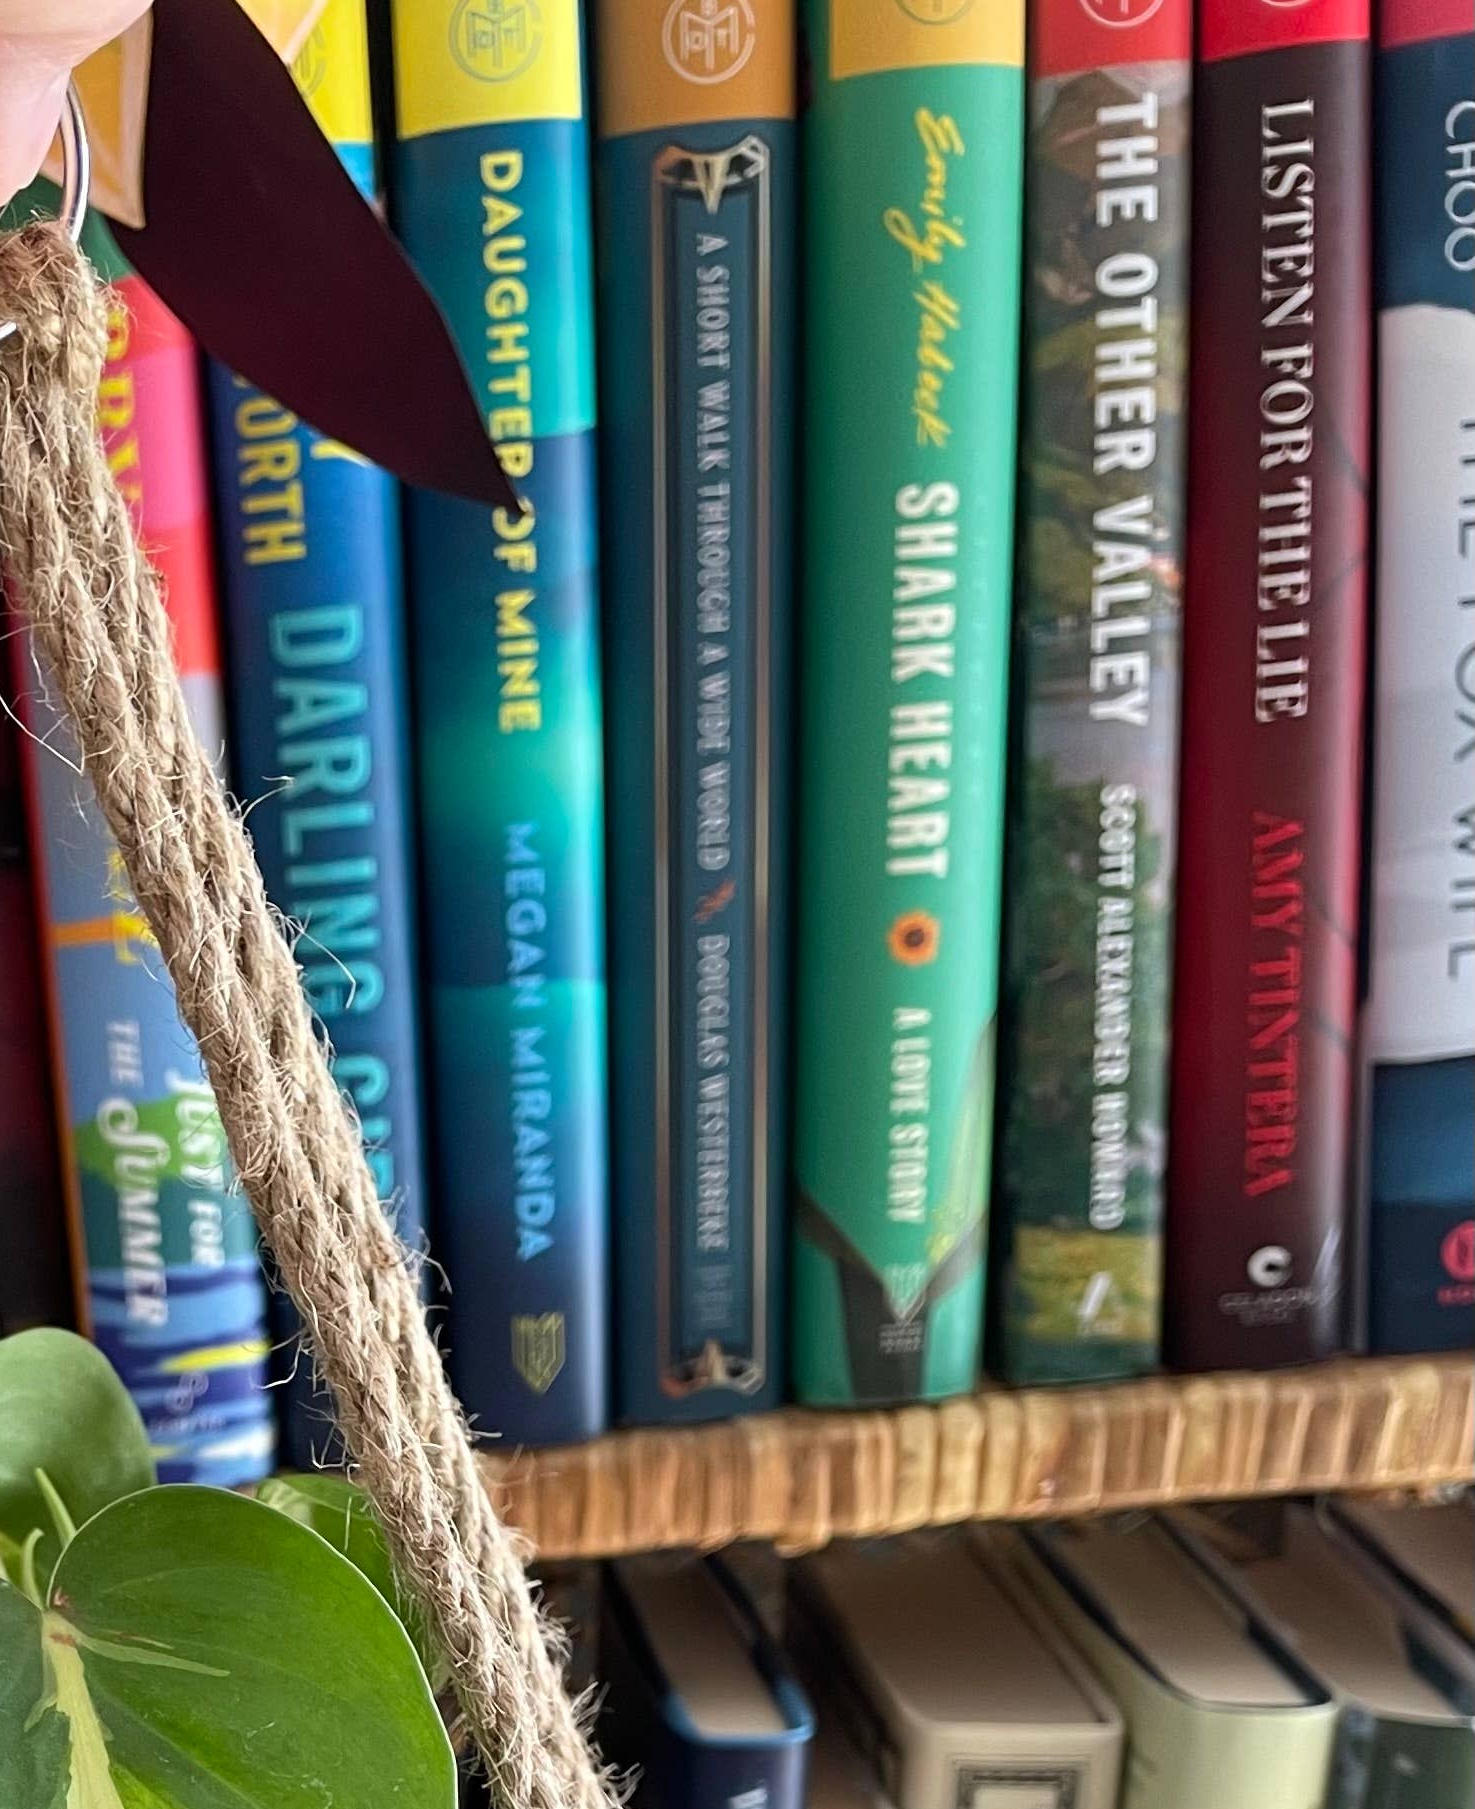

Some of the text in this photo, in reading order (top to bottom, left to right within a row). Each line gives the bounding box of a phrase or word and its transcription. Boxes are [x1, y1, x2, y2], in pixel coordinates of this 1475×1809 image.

[883, 105, 966, 274] Emily
[478, 149, 543, 736] DAUGHTER OF MINE
[695, 233, 732, 872] A SHORT WALK THROUGH A WIDE WORLD
[1086, 91, 1159, 729] THE OTHER VALLEY
[1253, 97, 1315, 725] LISTEN FOR THE LIE
[268, 603, 386, 1014] DARLING
[885, 481, 961, 881] SHARK HEART
[1098, 783, 1137, 890] SCOTT
[106, 1020, 144, 1088] THE
[500, 819, 554, 1264] MEGAN MIRANDA
[695, 933, 732, 1068] DOUGLAS
[886, 1007, 932, 1224] A LOVE STORY
[1093, 896, 1135, 1085] ALEXANDER
[1242, 810, 1306, 1200] AMY TINTERA
[96, 1097, 171, 1329] SUMMER
[189, 1201, 225, 1269] FOR
